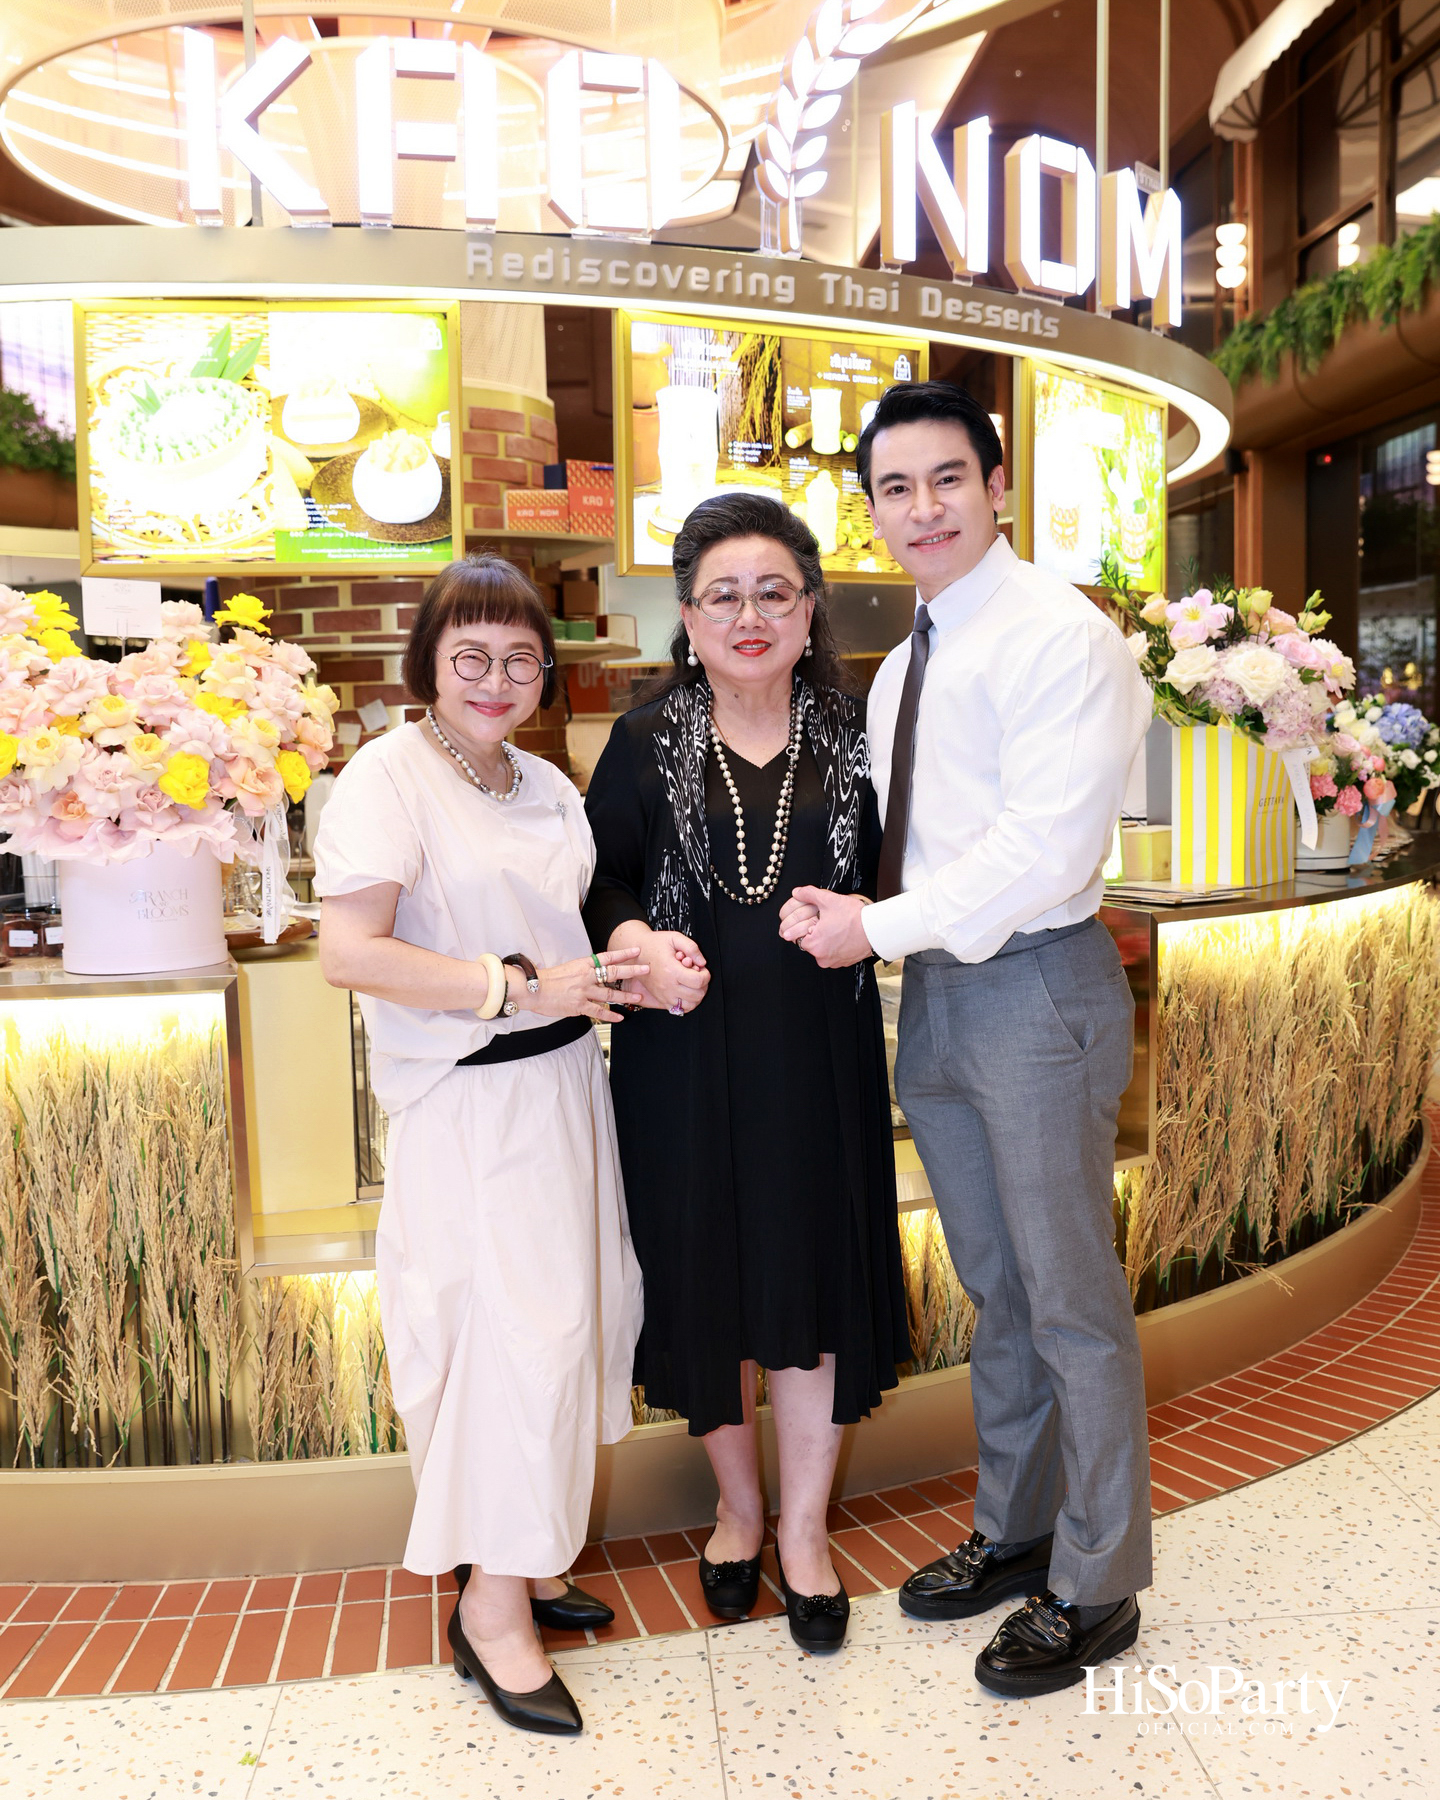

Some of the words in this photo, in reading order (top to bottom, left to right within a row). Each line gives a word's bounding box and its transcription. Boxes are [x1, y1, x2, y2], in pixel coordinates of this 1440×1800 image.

[184, 26, 681, 231] KAO
[880, 100, 1182, 328] NOM
[466, 242, 795, 305] Rediscovering
[818, 272, 900, 313] Thai
[921, 286, 1060, 339] Desserts
[137, 904, 190, 919] BLOOMS
